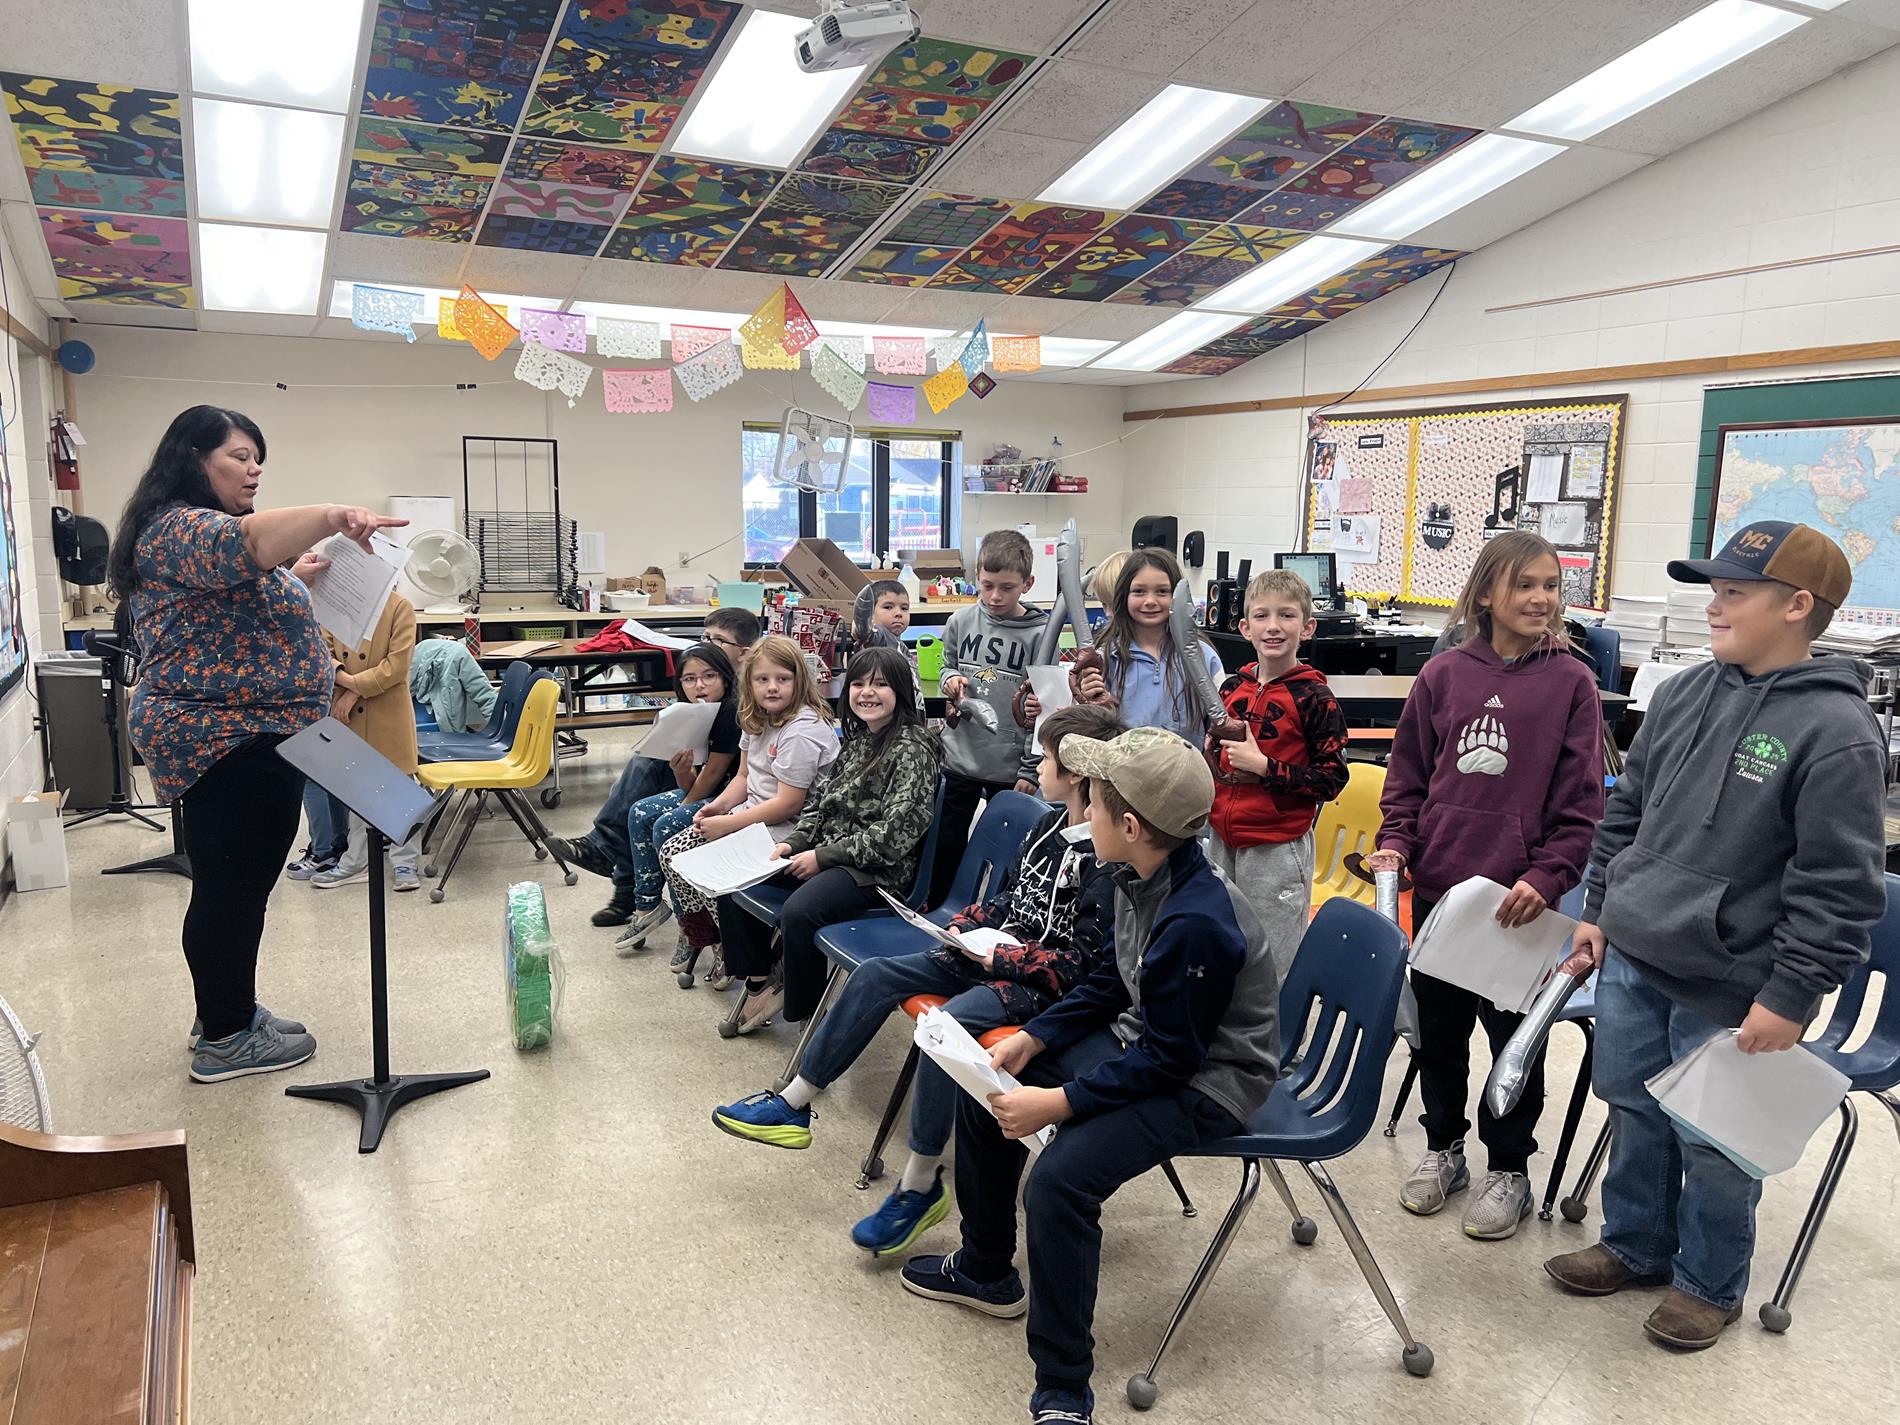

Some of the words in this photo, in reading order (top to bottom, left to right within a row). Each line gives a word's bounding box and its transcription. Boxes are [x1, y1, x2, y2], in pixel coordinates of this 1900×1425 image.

[1422, 525, 1453, 539] MUSIC
[1739, 530, 1774, 550] MC
[959, 633, 1026, 671] MSU
[1750, 764, 1774, 776] PLACE
